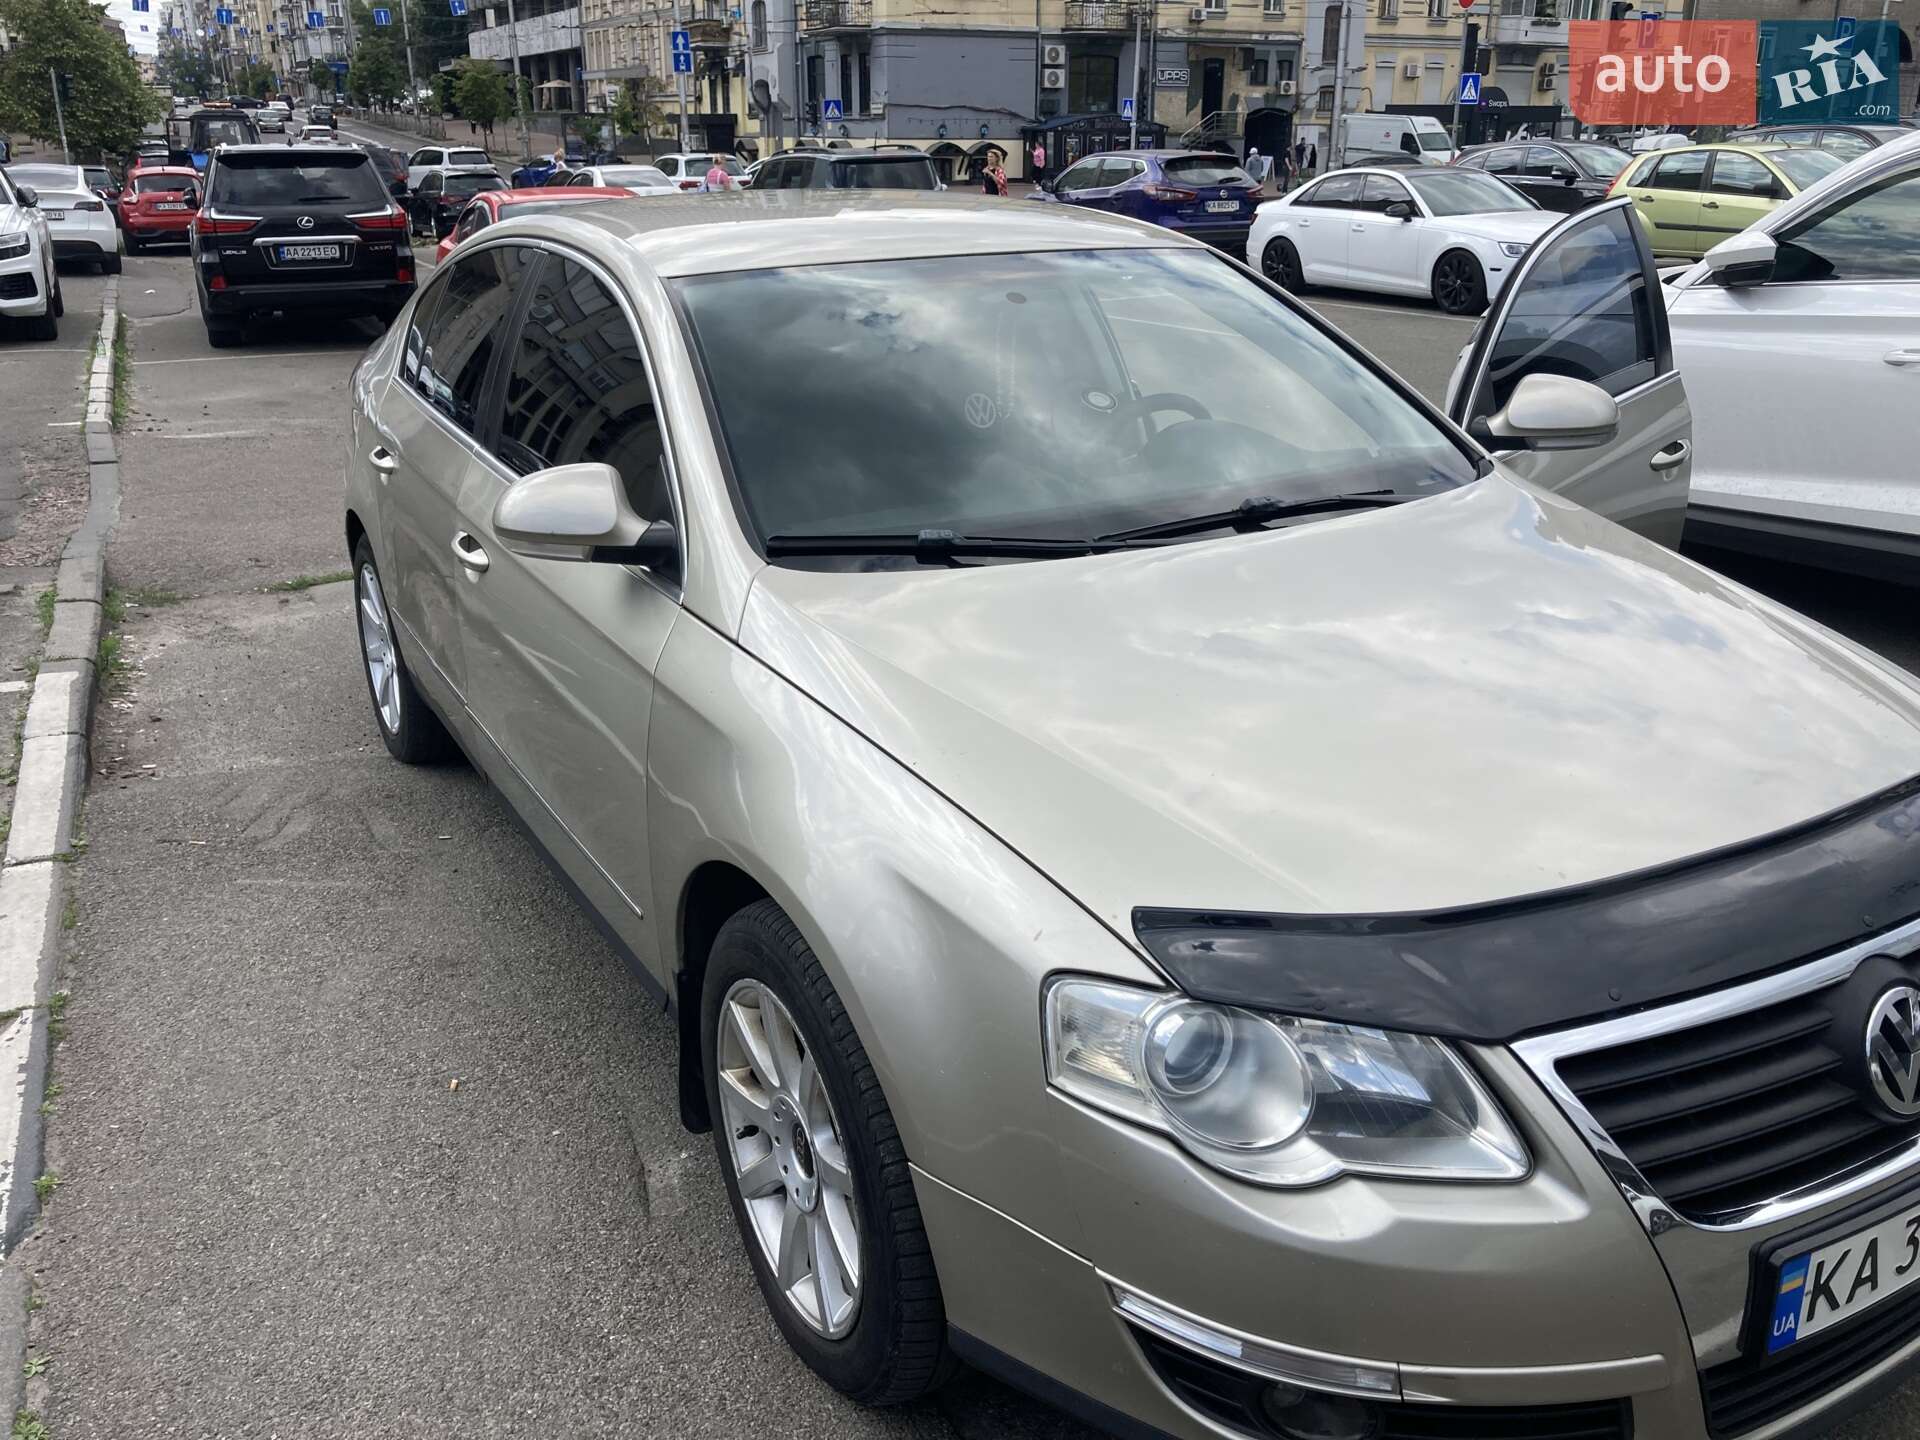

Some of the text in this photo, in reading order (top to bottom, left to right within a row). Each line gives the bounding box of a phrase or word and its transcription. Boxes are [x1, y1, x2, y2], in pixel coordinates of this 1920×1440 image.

[1158, 70, 1188, 80] UPPS
[1488, 99, 1508, 108] Swaps
[286, 246, 337, 257] AA 2213 EO
[1806, 1214, 1920, 1323] KA 3
[1773, 1313, 1795, 1337] UA
